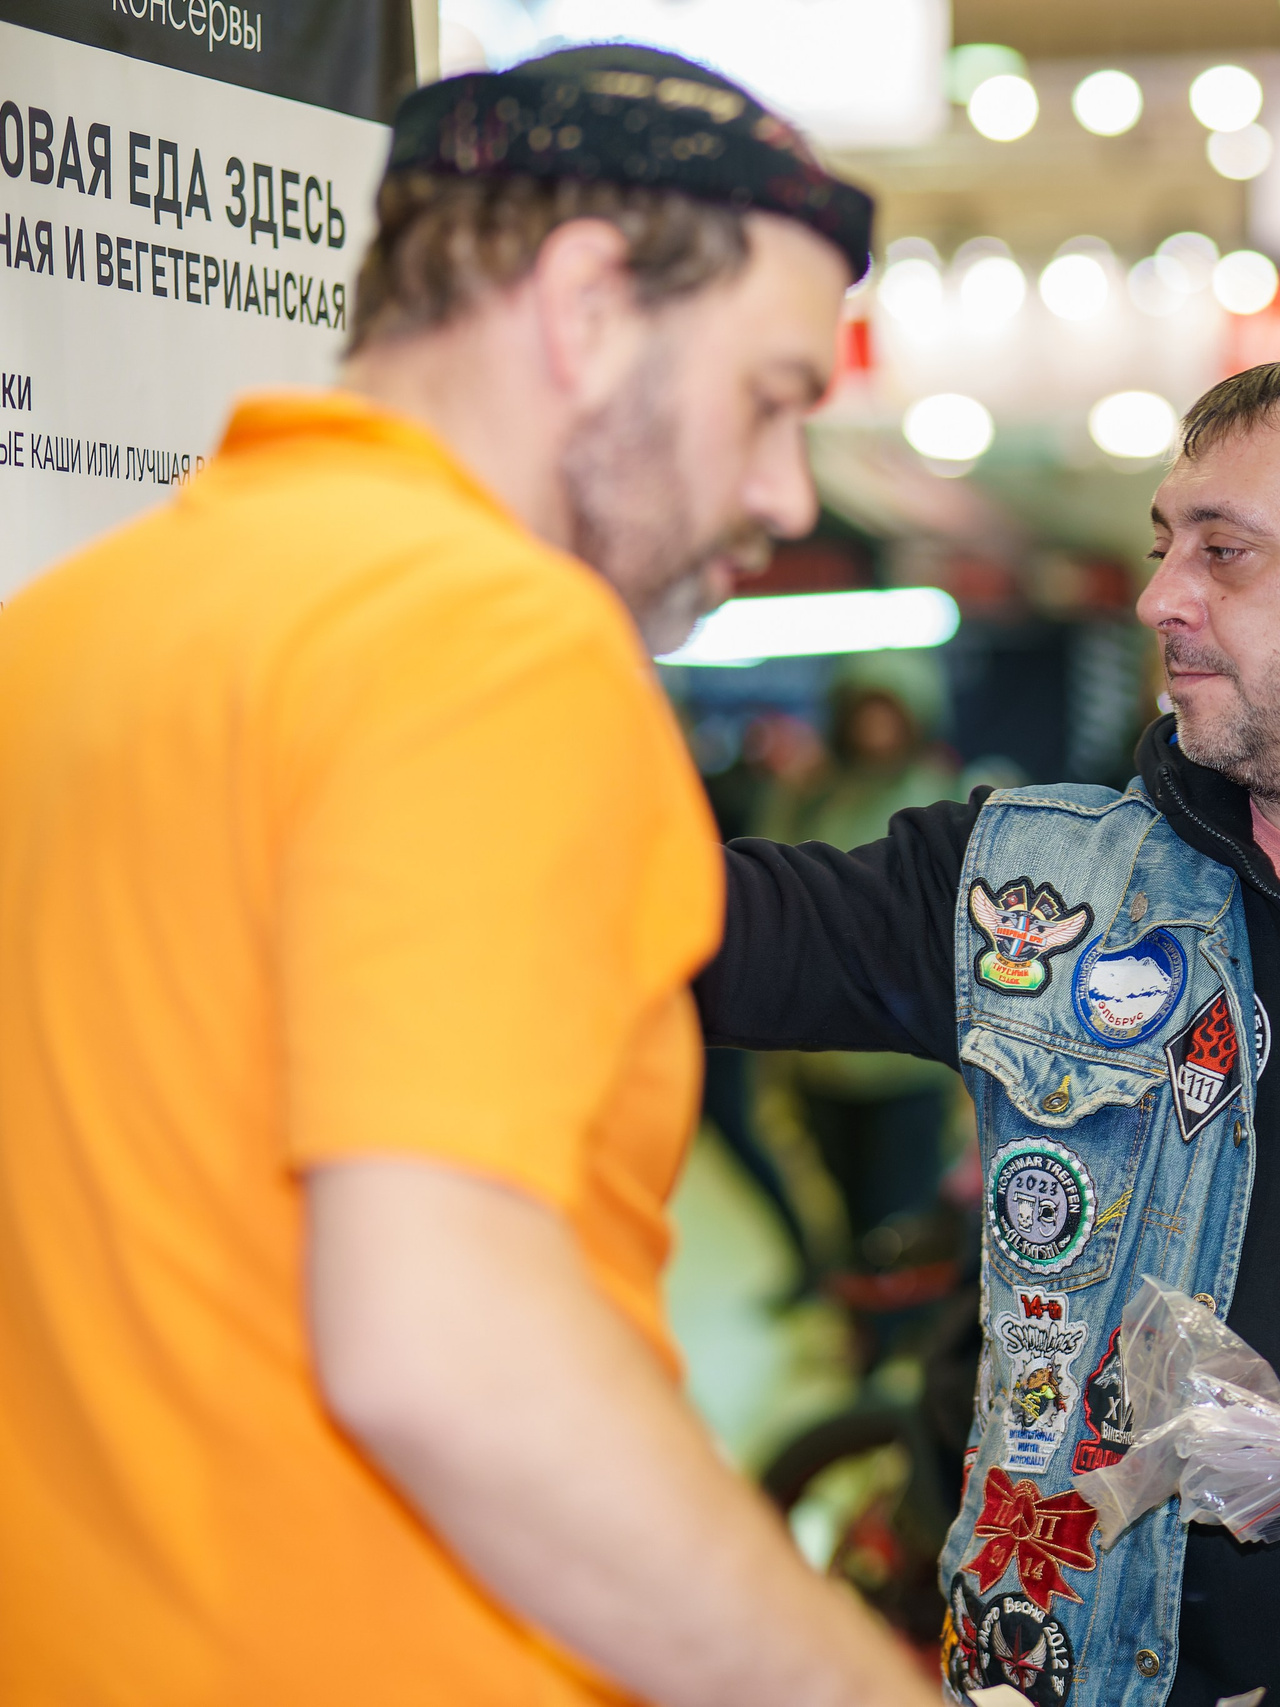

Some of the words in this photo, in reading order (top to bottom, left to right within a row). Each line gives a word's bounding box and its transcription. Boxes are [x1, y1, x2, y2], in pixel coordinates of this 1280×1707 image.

[0, 100, 111, 199] ОВАЯ
[129, 131, 212, 229] ЕДА
[225, 157, 346, 249] ЗДЕСЬ
[64, 225, 85, 281] И
[96, 232, 346, 331] ВЕГЕТЕРИАНСКАЯ
[31, 433, 81, 474] КАШИ
[87, 440, 119, 478] ИЛИ
[125, 446, 190, 486] ЛУЧШАЯ
[1098, 1001, 1144, 1026] ЭЛЬБРУС
[998, 1156, 1042, 1194] KOSHMAR
[1046, 1158, 1080, 1214] TREFFEN
[1015, 1174, 1058, 1196] 2023
[1043, 1622, 1069, 1669] 2012
